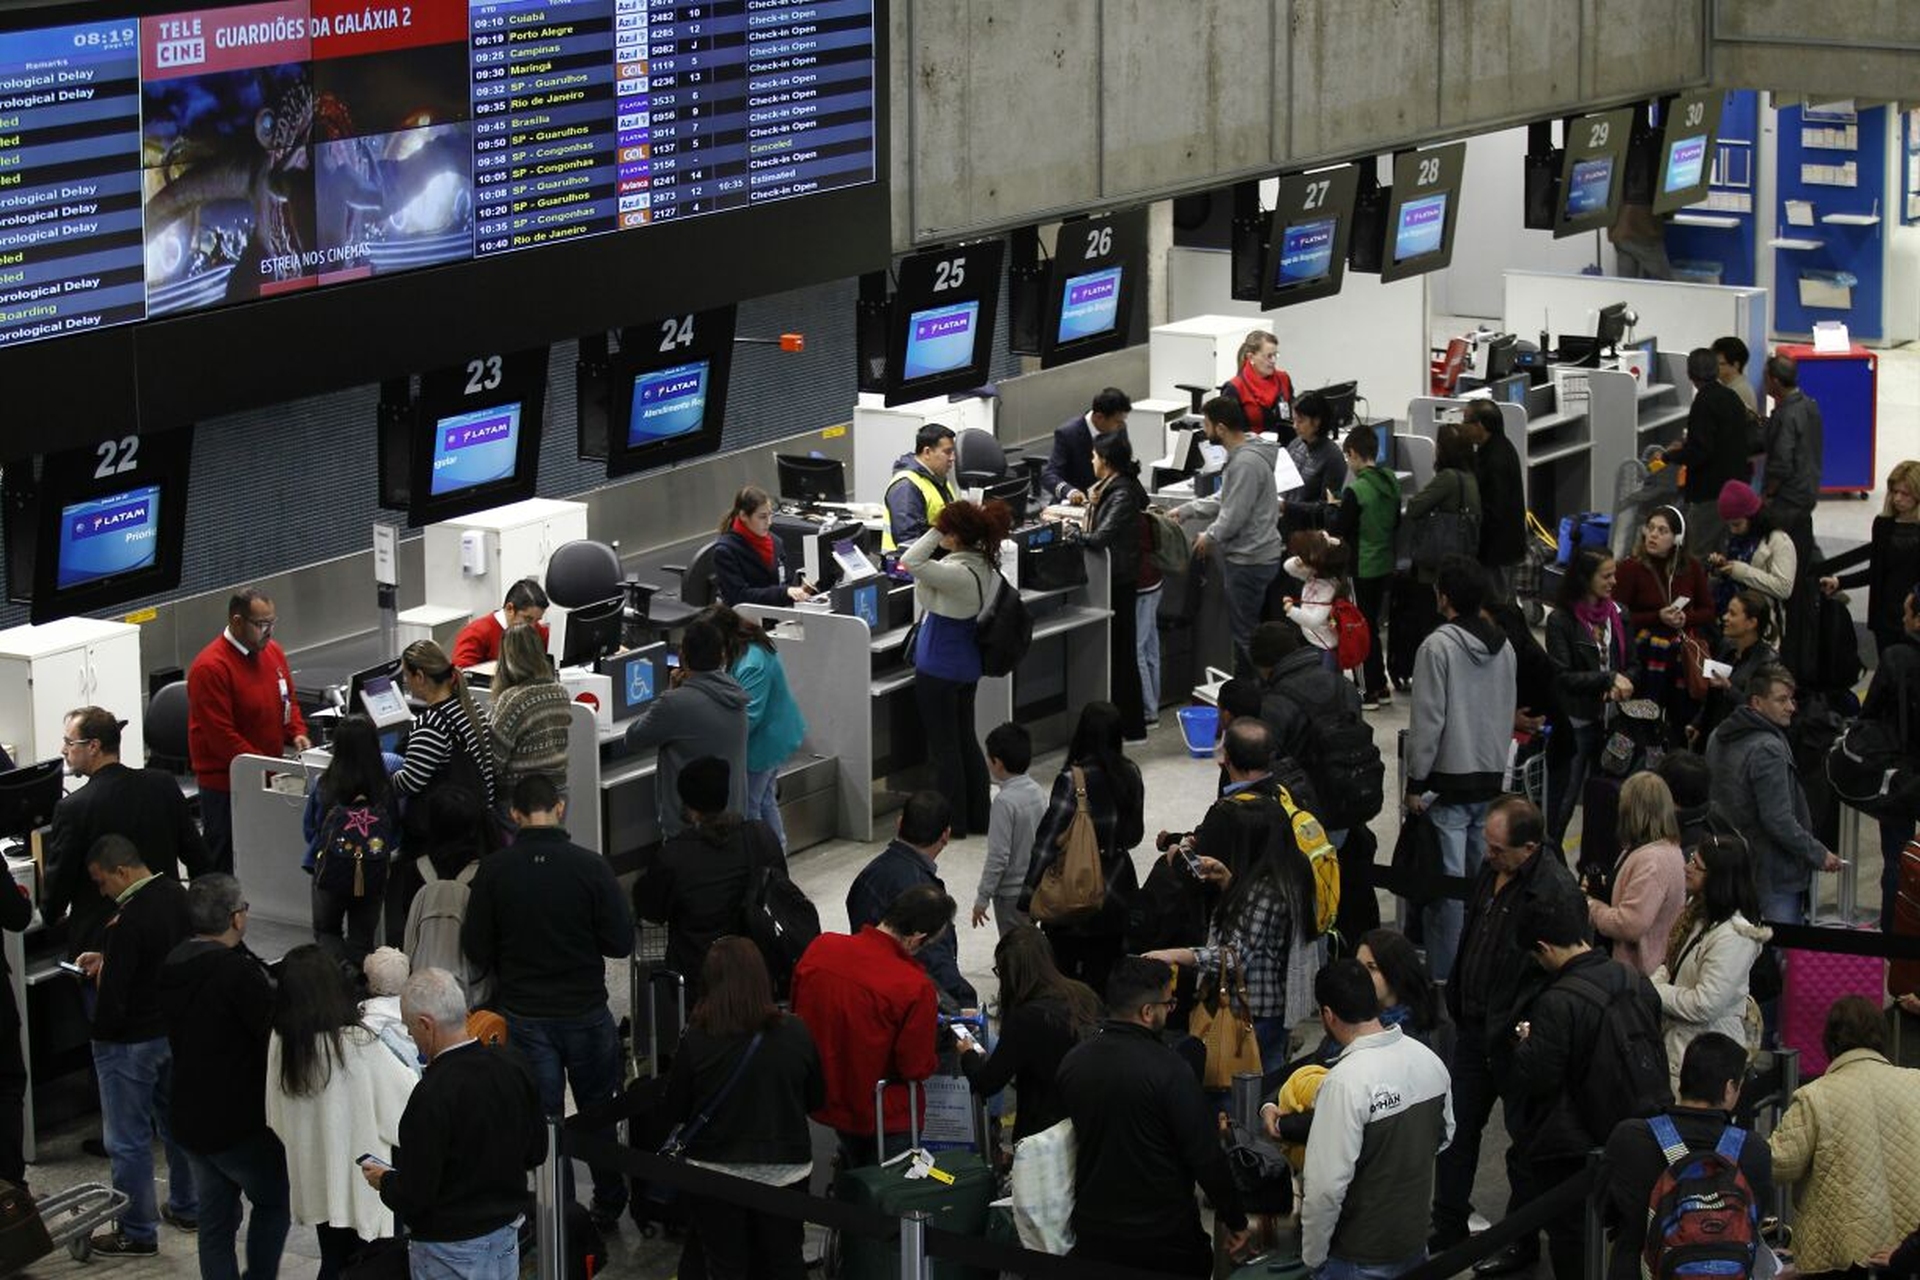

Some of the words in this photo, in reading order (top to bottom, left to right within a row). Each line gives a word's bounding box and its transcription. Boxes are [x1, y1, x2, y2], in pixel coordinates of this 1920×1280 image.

[160, 18, 202, 40] TELE
[215, 16, 304, 48] GUARDIÕES
[311, 18, 330, 38] DA
[334, 7, 398, 34] GALÁXIA
[402, 7, 412, 26] 2
[474, 17, 504, 28] 09:10
[509, 12, 544, 24] Cuiabá
[475, 34, 504, 46] 09:19
[510, 29, 538, 41] Porto
[541, 26, 574, 38] Alegre
[748, 0, 788, 9] Check-in
[74, 28, 134, 46] 08:19
[476, 51, 504, 62] 09:25
[510, 45, 560, 58] Campinas
[749, 14, 789, 25] Check-in
[792, 10, 816, 20] Open
[26, 59, 68, 70] Remarks
[160, 42, 203, 63] CINE
[476, 68, 504, 80] 09:30
[510, 62, 552, 75] Maringá
[749, 29, 789, 40] Check-in
[792, 26, 816, 36] Open
[58, 70, 94, 82] Delay
[476, 85, 505, 96] 09:32
[510, 82, 525, 92] SP
[536, 74, 588, 87] Guarulhos
[750, 44, 789, 56] Check-in
[792, 41, 816, 51] Open
[58, 88, 94, 101] Delay
[476, 102, 506, 114] 09:35
[511, 98, 528, 109] Rio
[531, 96, 543, 106] de
[547, 90, 584, 104] Janeiro
[750, 60, 790, 72] Check-in
[792, 57, 816, 67] Open
[478, 120, 506, 132] 09:45
[512, 115, 550, 128] Brasília
[750, 78, 790, 90] Check-in
[792, 74, 816, 84] Open
[1686, 102, 1704, 127] 30
[478, 138, 506, 150] 09:50
[512, 134, 526, 144] SP
[536, 126, 589, 140] Guarulhos
[750, 94, 790, 106] Check-in
[792, 90, 816, 100] Open
[1588, 122, 1608, 148] 29
[478, 155, 506, 167] 09:58
[512, 152, 526, 162] SP
[536, 142, 594, 157] Congonhas
[750, 109, 790, 121] Check-in
[792, 106, 816, 116] Open
[478, 172, 507, 184] 10:05
[512, 168, 526, 178] SP
[537, 158, 594, 174] Congonhas
[750, 124, 790, 137] Check-in
[792, 120, 817, 131] Open
[479, 189, 507, 200] 10:08
[512, 185, 527, 195] SP
[538, 176, 590, 190] Guarulhos
[751, 140, 792, 153] Canceled
[479, 206, 508, 217] 10:20
[513, 202, 528, 212] SP
[538, 192, 590, 207] Guarulhos
[750, 156, 790, 168] Check-in
[792, 151, 817, 162] Open
[1417, 158, 1440, 186] 28
[62, 185, 96, 198] Delay
[480, 222, 508, 234] 10:35
[513, 218, 528, 228] SP
[538, 207, 596, 224] Congonhas
[751, 169, 796, 184] Estimated
[1303, 180, 1330, 210] 27
[62, 204, 98, 216] Delay
[480, 239, 508, 251] 10:40
[514, 234, 531, 246] Rio
[534, 231, 547, 241] de
[549, 225, 587, 239] Janeiro
[751, 186, 790, 200] Check-in
[793, 182, 818, 192] Open
[62, 222, 98, 235] Delay
[1084, 226, 1112, 260] 26
[261, 254, 300, 274] ESTREIA
[302, 250, 325, 266] NOS
[327, 242, 372, 262] CINEMAS
[64, 278, 100, 292] Delay
[932, 258, 966, 292] 25
[66, 316, 101, 328] Delay
[658, 314, 695, 354] 24
[938, 319, 967, 330] LATAM
[463, 355, 503, 396] 23
[666, 380, 697, 393] LATAM
[472, 424, 507, 438] LATAM
[94, 435, 140, 480] 22
[104, 508, 145, 525] LATAM
